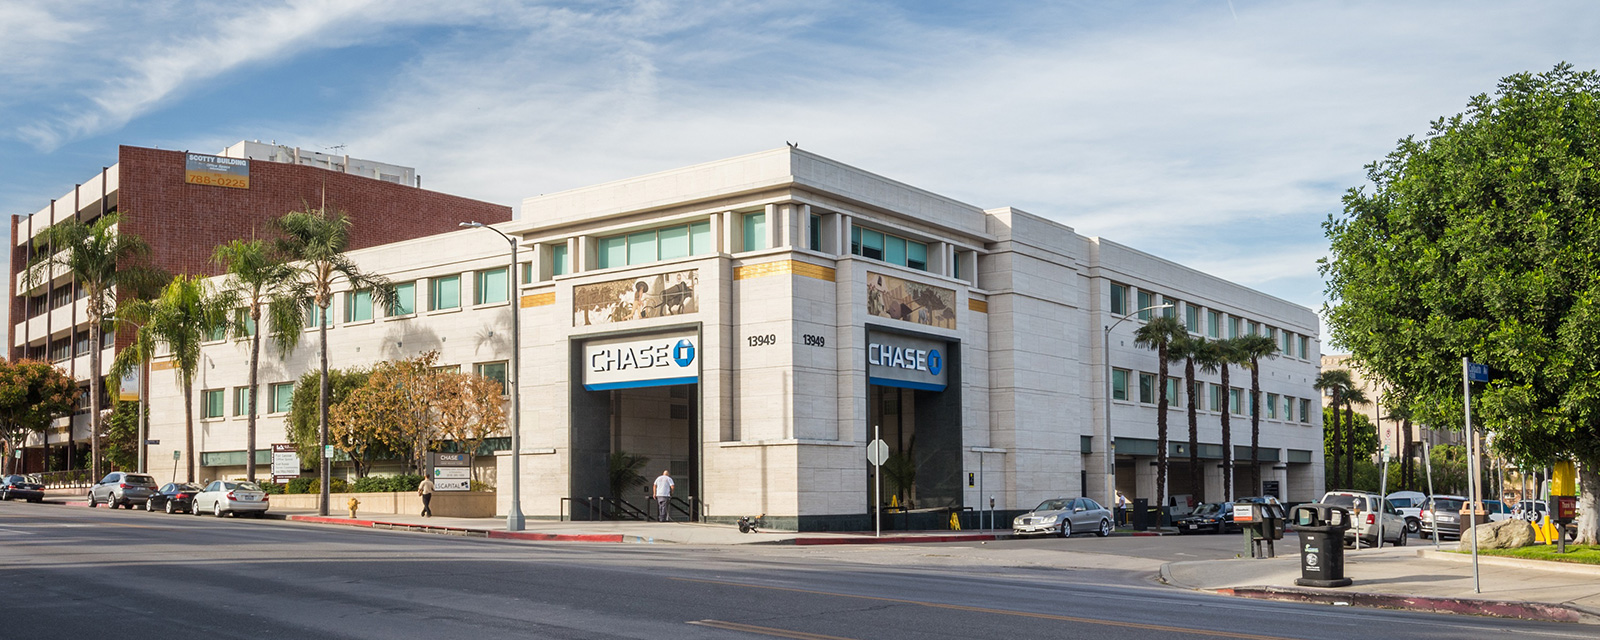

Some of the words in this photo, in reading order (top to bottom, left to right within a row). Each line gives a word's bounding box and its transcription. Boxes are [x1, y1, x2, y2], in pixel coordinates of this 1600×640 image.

[189, 154, 215, 163] SCOTTY
[217, 157, 247, 166] BUILDING
[189, 174, 246, 188] 788-0225
[747, 334, 776, 347] 13949
[803, 334, 825, 347] 13949
[592, 344, 670, 372] CHASE
[868, 343, 927, 372] CHASE
